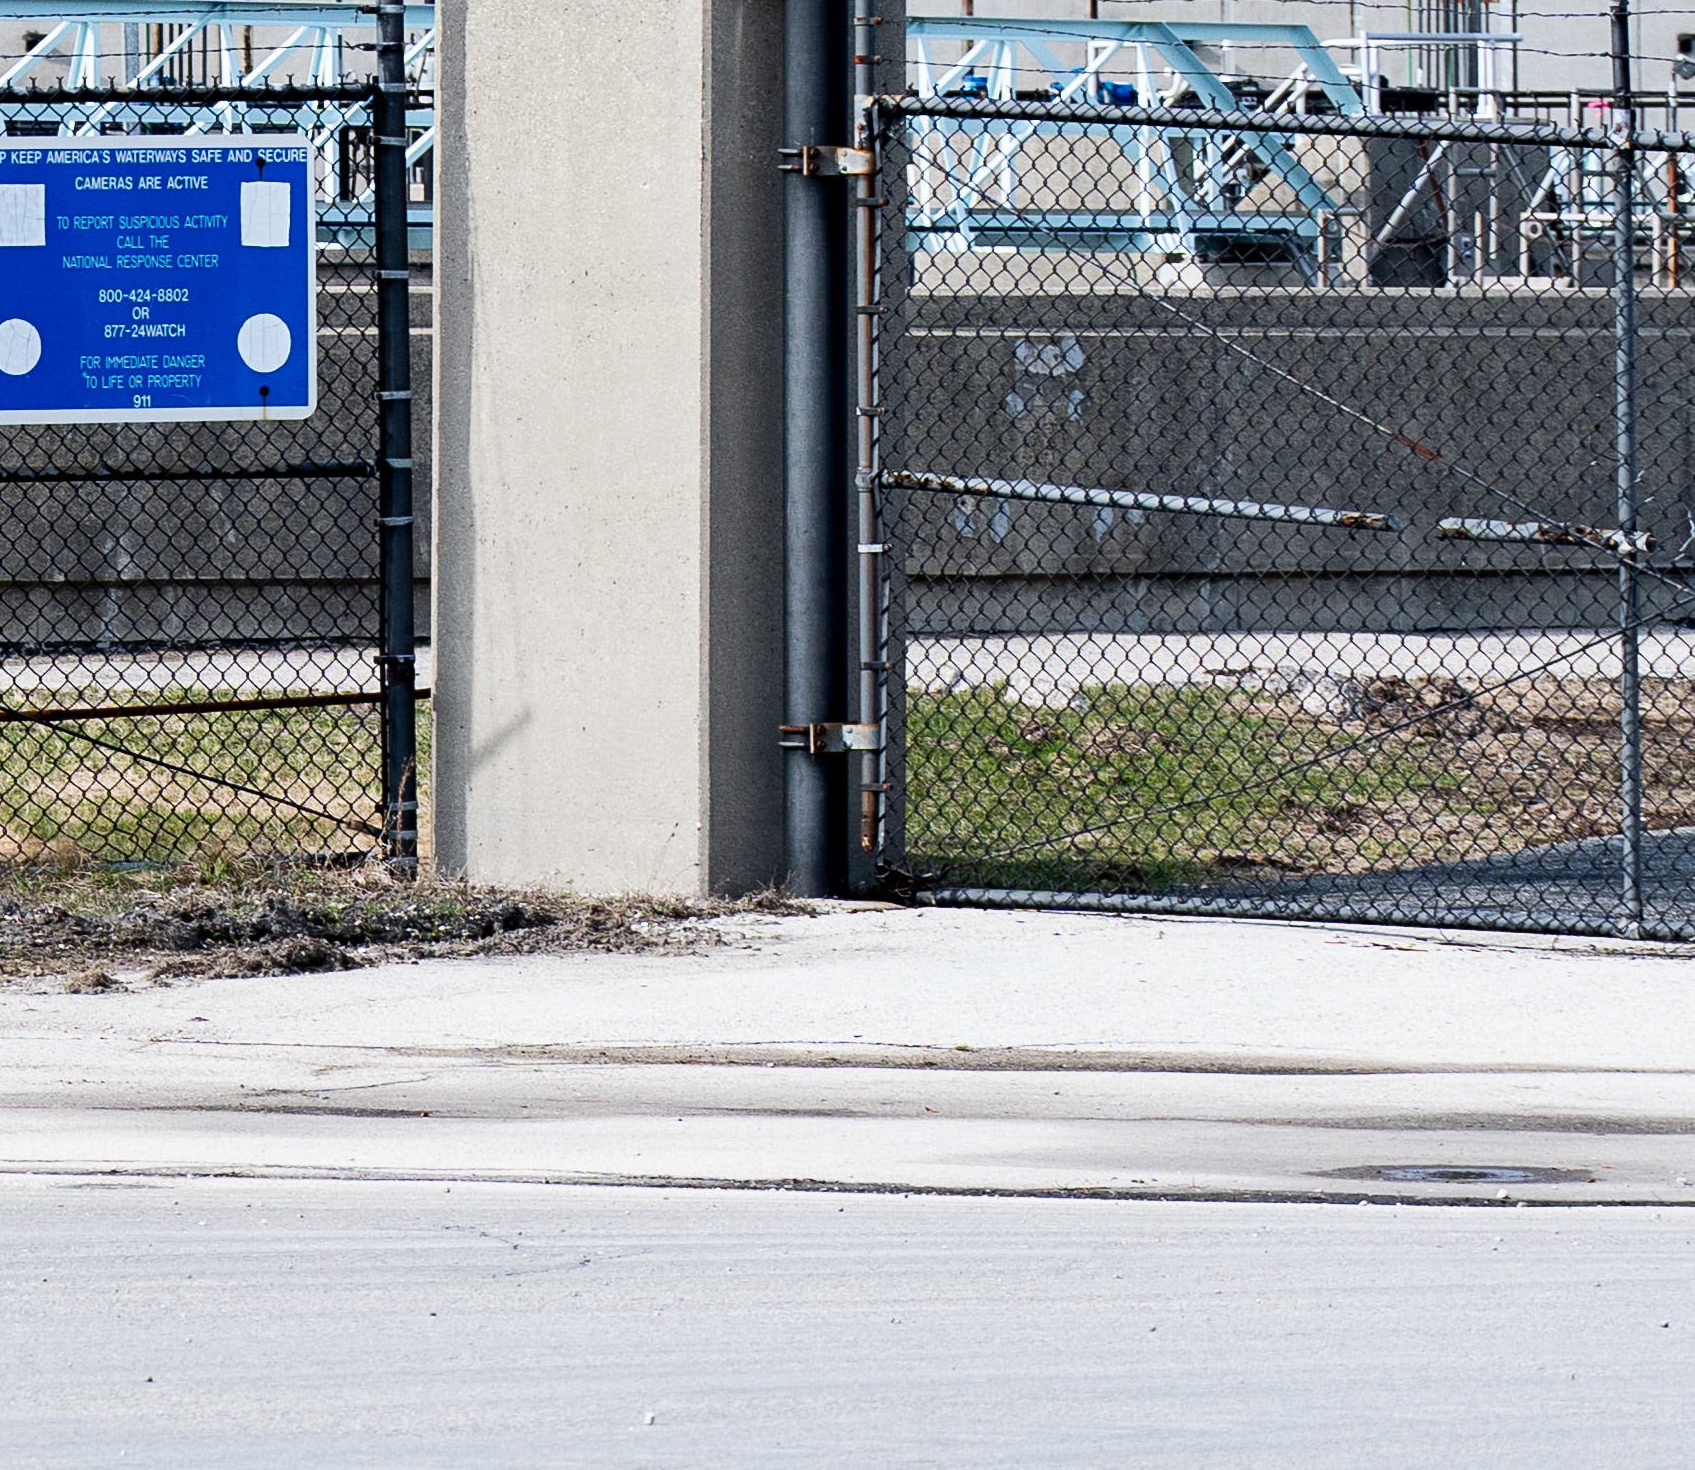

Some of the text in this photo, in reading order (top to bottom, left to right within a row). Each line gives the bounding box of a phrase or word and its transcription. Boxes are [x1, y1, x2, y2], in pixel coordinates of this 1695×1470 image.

[11, 151, 42, 164] KEEP
[47, 150, 110, 163] AMERICA'S
[116, 150, 186, 163] WATERWAYS
[192, 150, 222, 163] SAFE
[227, 150, 252, 162] AND
[258, 149, 307, 162] SECURE
[75, 176, 208, 190] CAMERAS ARE ACTIVE
[57, 215, 227, 229] TO REPORT SUSPICIOUS ACTIVITY
[117, 235, 169, 248] CALL THE
[63, 254, 218, 268] NATIONAL RESPONSE CENTER
[99, 289, 188, 302] 800-424-8802
[132, 307, 149, 319] OR
[105, 324, 185, 338] 877-24WATCH
[80, 355, 205, 369] FOR IMMEDIATE DANGER
[85, 375, 201, 388] TO LIFE OR PROPERTY
[133, 395, 153, 409] 911
